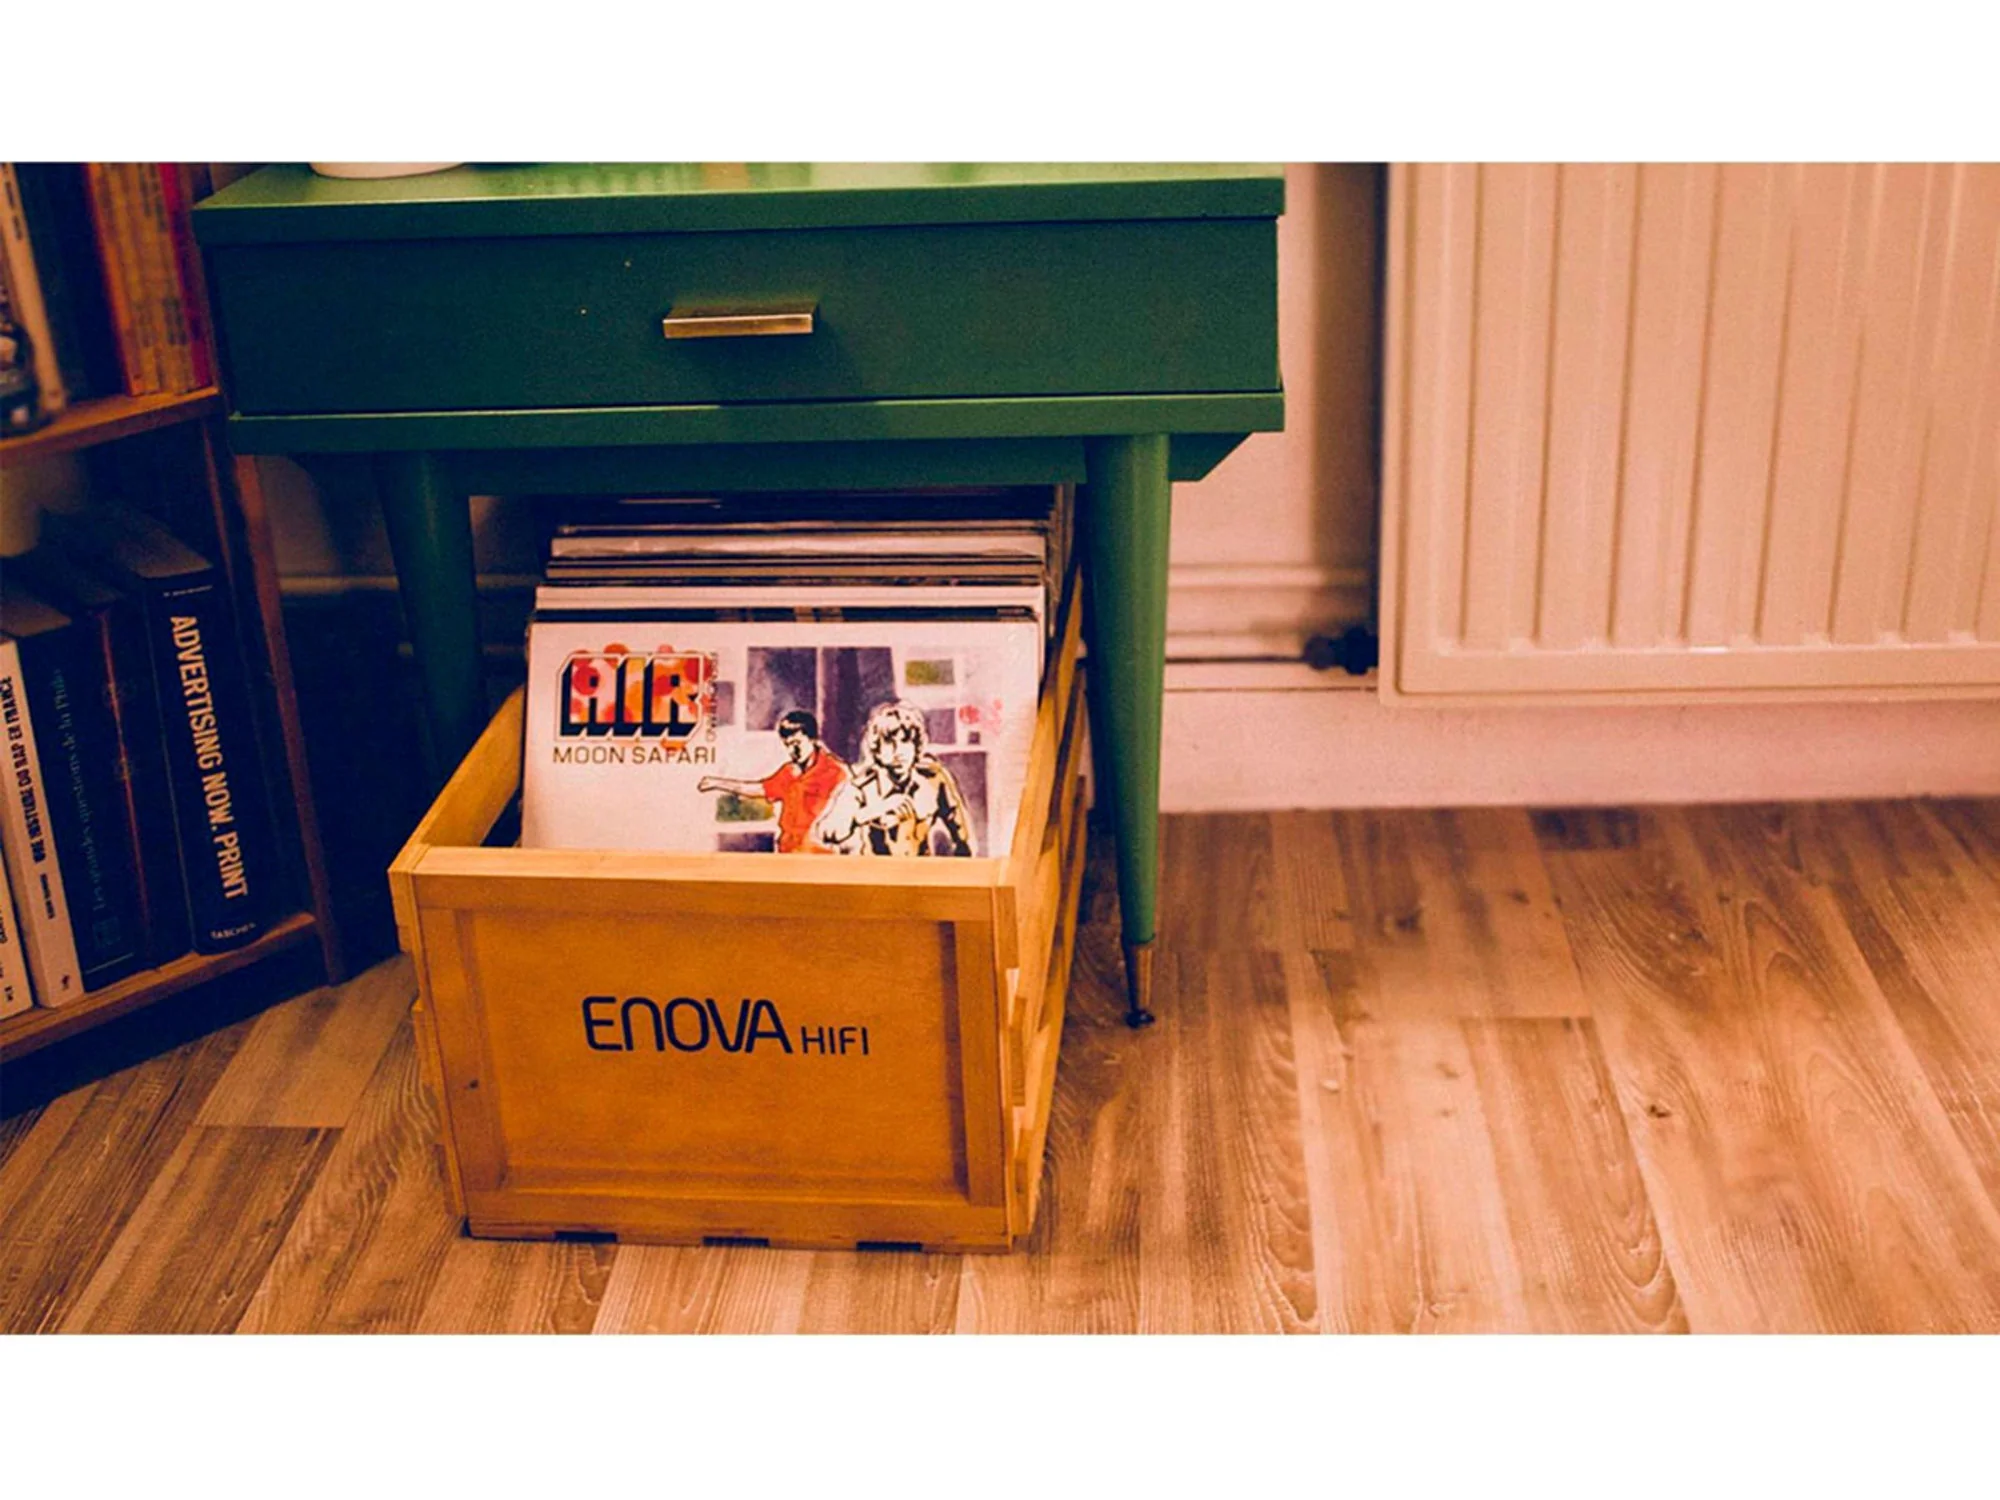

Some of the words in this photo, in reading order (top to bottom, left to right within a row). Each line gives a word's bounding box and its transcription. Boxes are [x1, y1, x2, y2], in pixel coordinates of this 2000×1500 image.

[0, 675, 20, 724] FRANCE
[170, 615, 224, 770] ADVERTISING
[559, 656, 699, 737] AIR
[11, 743, 29, 770] RAP
[552, 746, 625, 764] MOON
[631, 746, 717, 765] SAFARI
[201, 771, 235, 832] NOW.
[213, 831, 249, 899] PRINT
[582, 996, 793, 1054] ENOVA
[801, 1026, 869, 1055] HIFI
